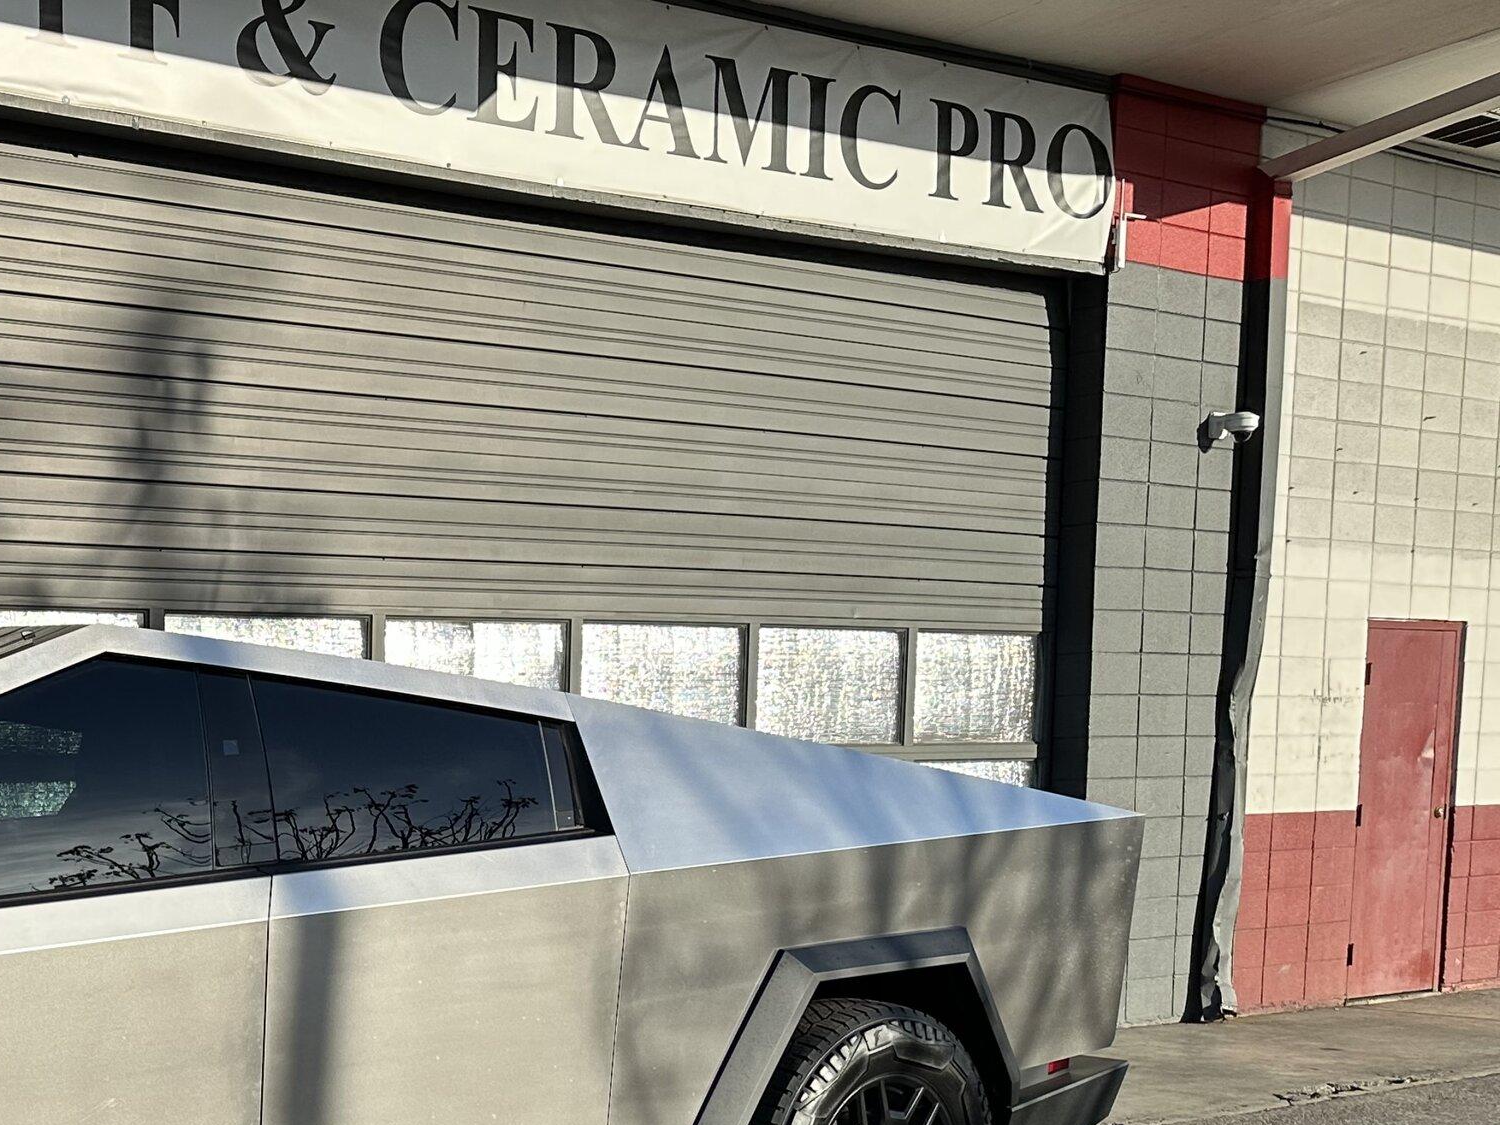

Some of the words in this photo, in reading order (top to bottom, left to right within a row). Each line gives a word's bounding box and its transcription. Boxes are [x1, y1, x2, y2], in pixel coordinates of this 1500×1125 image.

[236, 0, 337, 96] &
[379, 0, 902, 191] CERAMIC
[927, 98, 1113, 220] PRO
